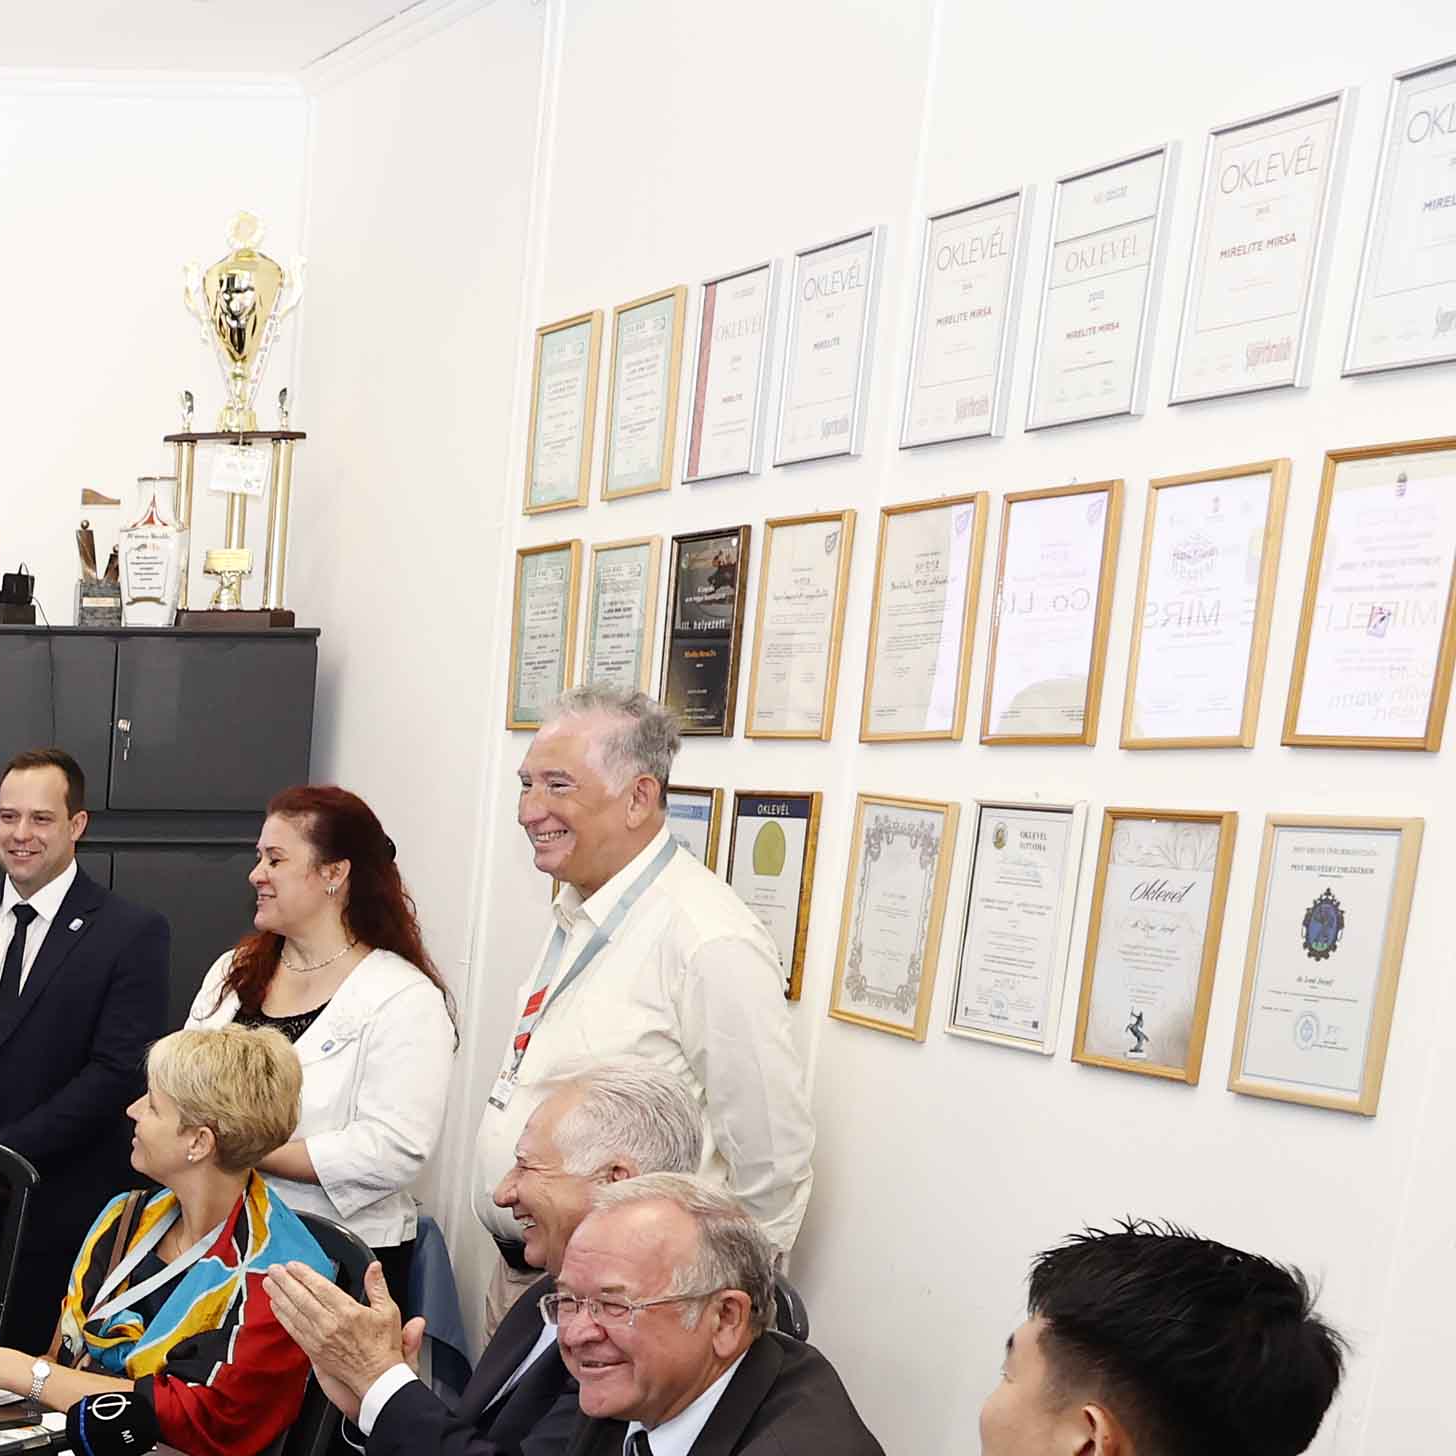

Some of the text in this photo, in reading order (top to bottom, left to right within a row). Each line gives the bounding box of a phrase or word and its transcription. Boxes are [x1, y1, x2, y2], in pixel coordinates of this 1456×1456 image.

[1220, 136, 1318, 194] OKLEVÉL
[937, 224, 1008, 271] OKLEVÉL
[1219, 232, 1296, 259] MIRELITE MIRSA
[803, 263, 865, 301] OKLEVÉL
[756, 803, 790, 816] OKLEVÉL
